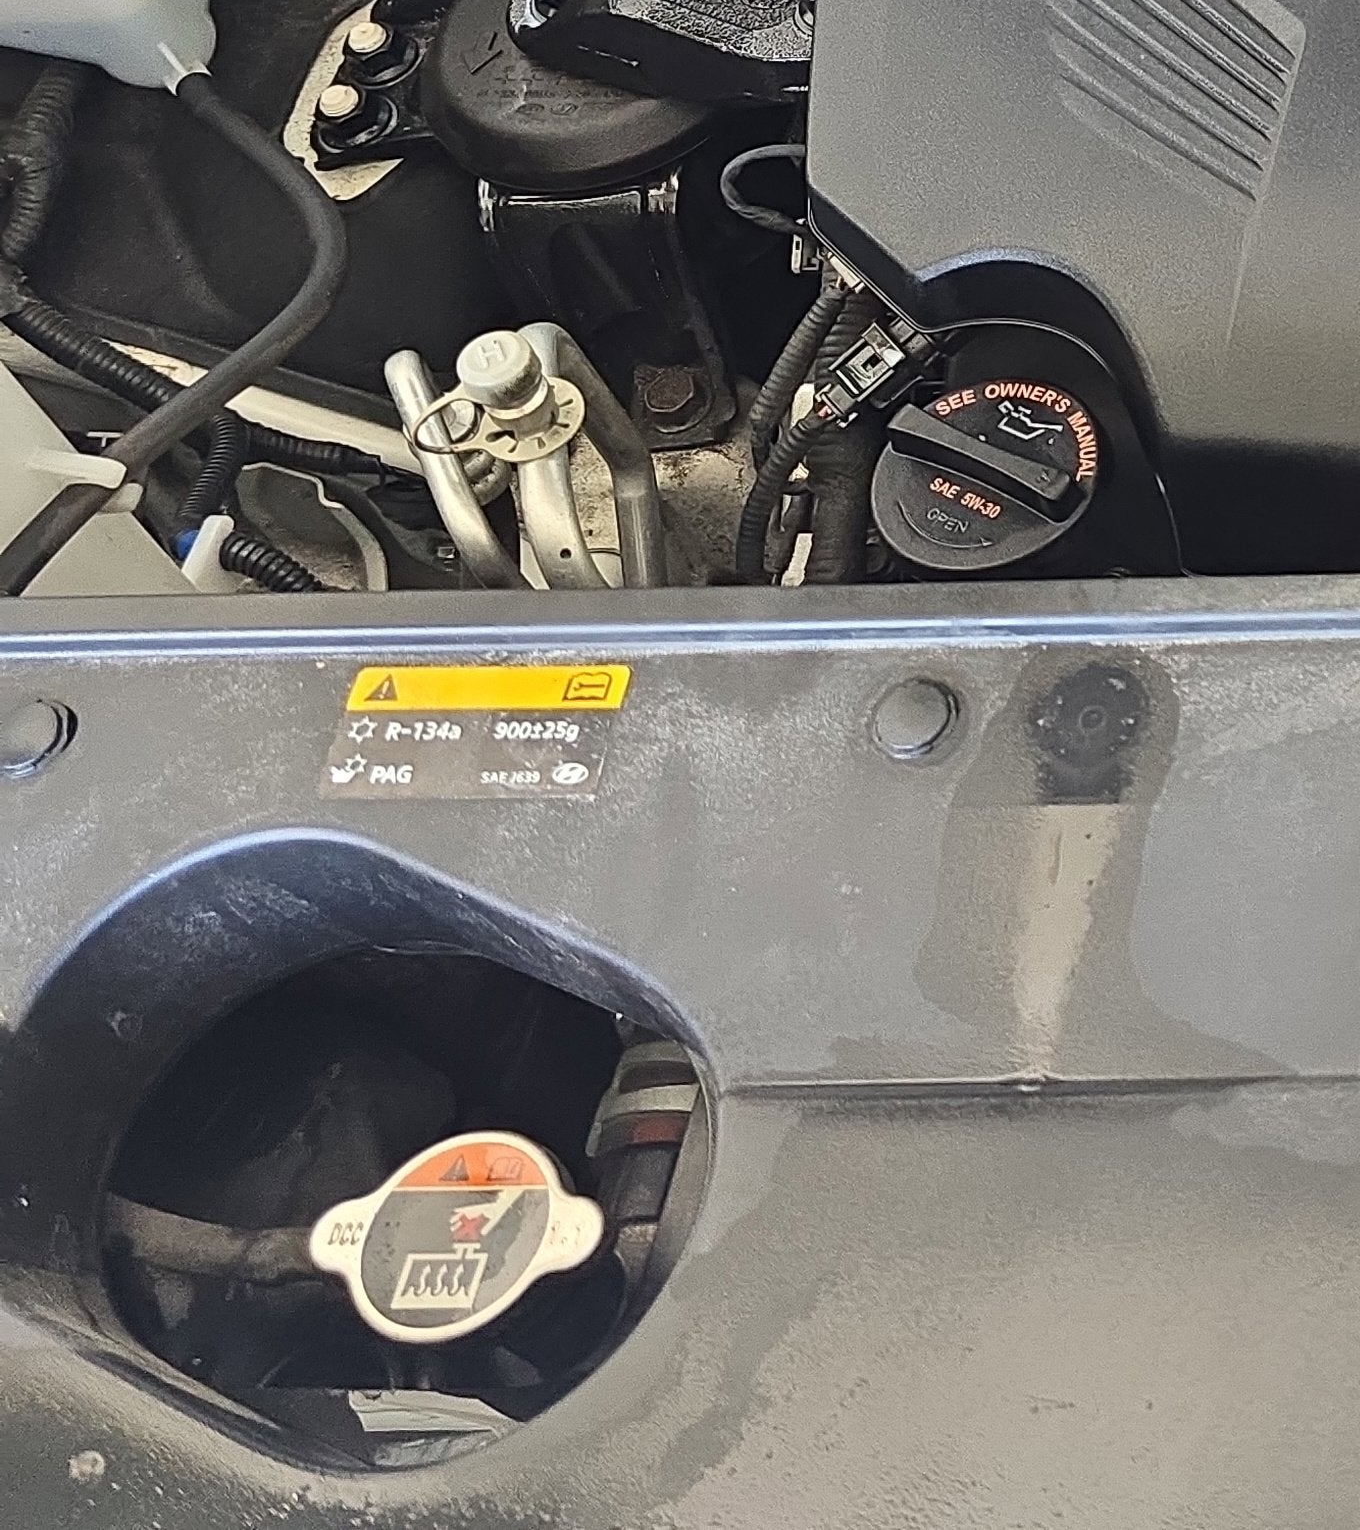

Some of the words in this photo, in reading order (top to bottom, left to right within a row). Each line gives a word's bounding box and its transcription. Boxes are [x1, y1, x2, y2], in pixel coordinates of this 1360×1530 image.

[935, 389, 976, 416] SEE
[984, 383, 1072, 413] OWNER'S
[1067, 411, 1097, 482] MANUAL
[929, 477, 960, 500] SAE
[960, 492, 1001, 519] 5W-30
[926, 507, 970, 533] OPEN
[385, 722, 462, 740] R-134a
[369, 765, 414, 784] PAG
[480, 771, 508, 784] SAE
